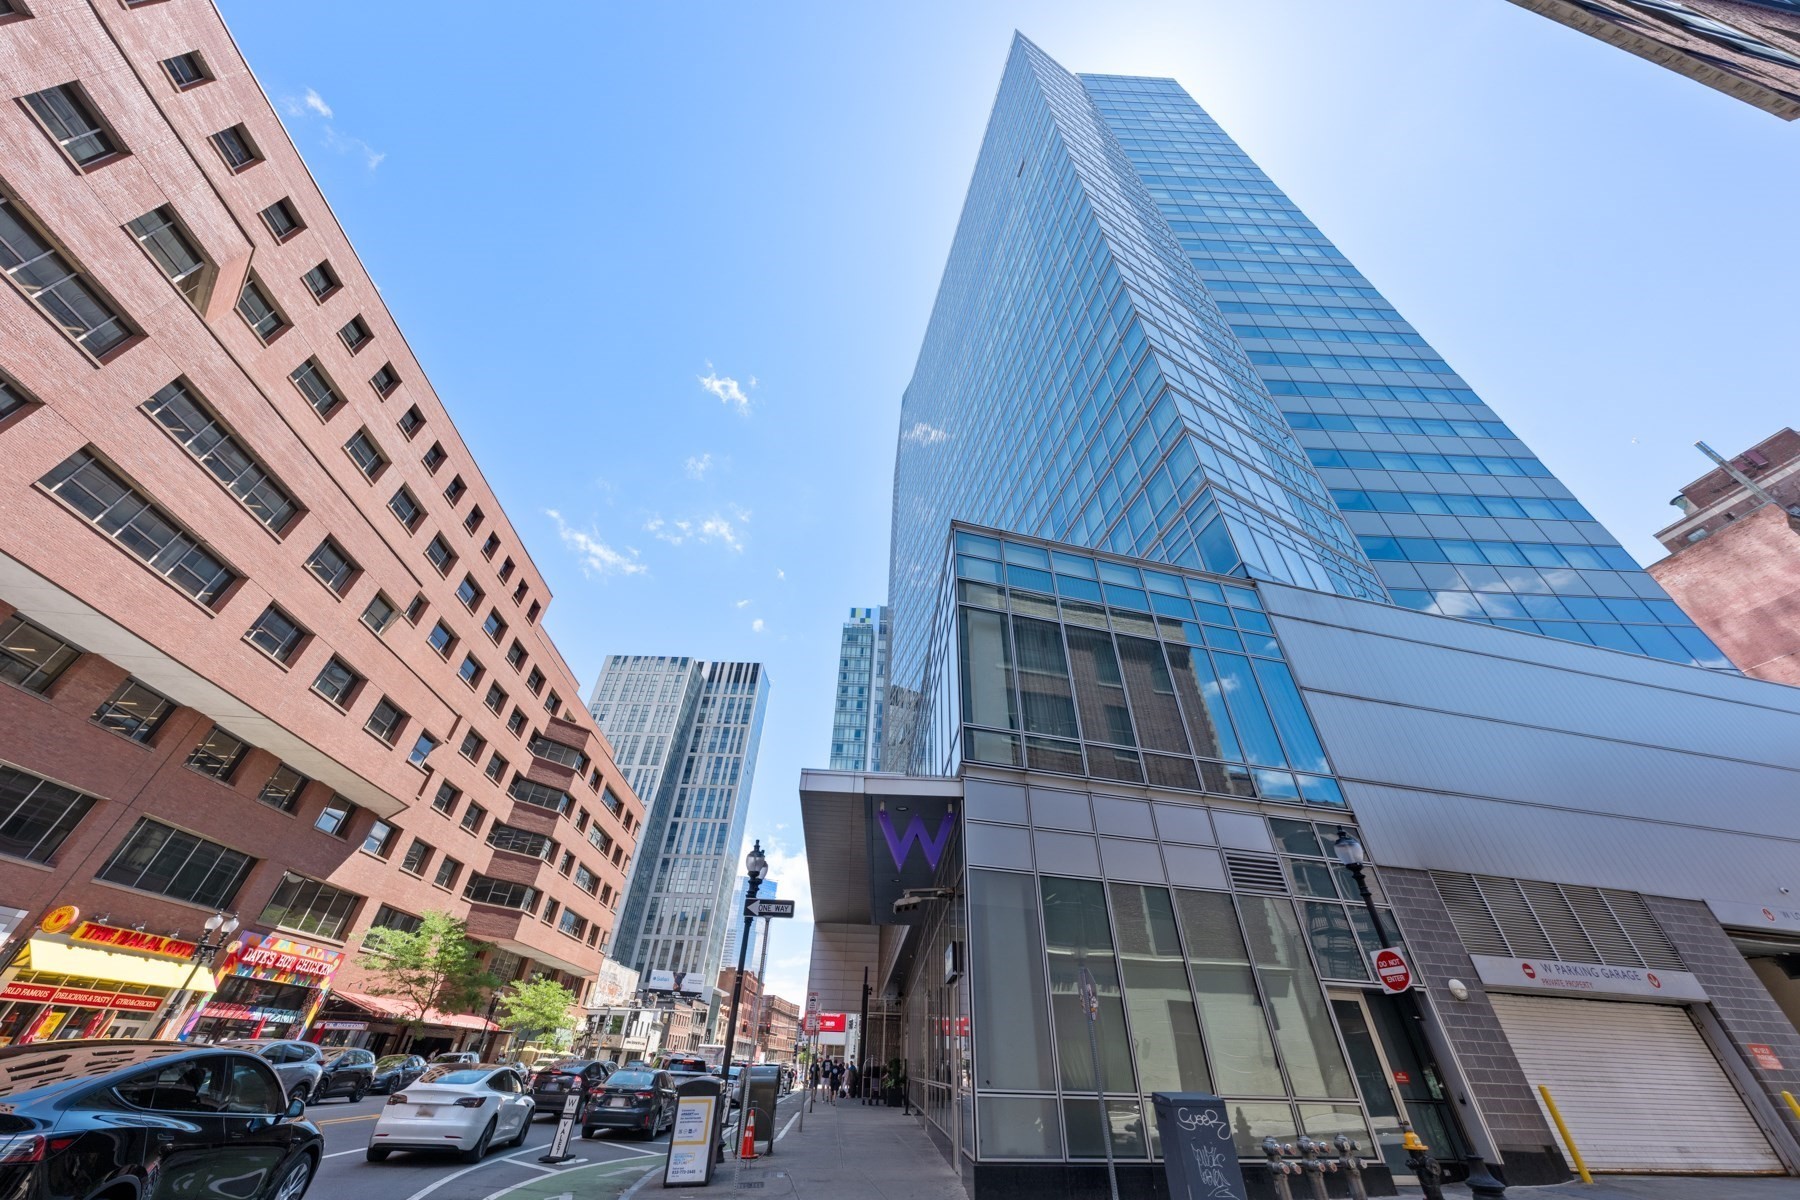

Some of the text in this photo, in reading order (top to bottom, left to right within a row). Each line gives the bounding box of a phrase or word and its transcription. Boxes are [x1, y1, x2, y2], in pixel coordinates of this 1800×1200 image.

[878, 810, 956, 873] W
[758, 904, 772, 912] ONE
[80, 923, 197, 958] THE HALAL GUY
[242, 948, 334, 975] DAVE'S HOT CHICKEN
[1388, 958, 1400, 966] NOT
[1540, 963, 1641, 981] W PARKING GARAGE
[1386, 975, 1405, 983] ENTER
[1541, 978, 1594, 989] PRIVATE PROPERTY
[4, 986, 50, 998] ORLD FAMOUS
[55, 991, 89, 1002] DELICIOUS
[568, 1098, 577, 1107] W
[556, 1121, 568, 1155] VALET
